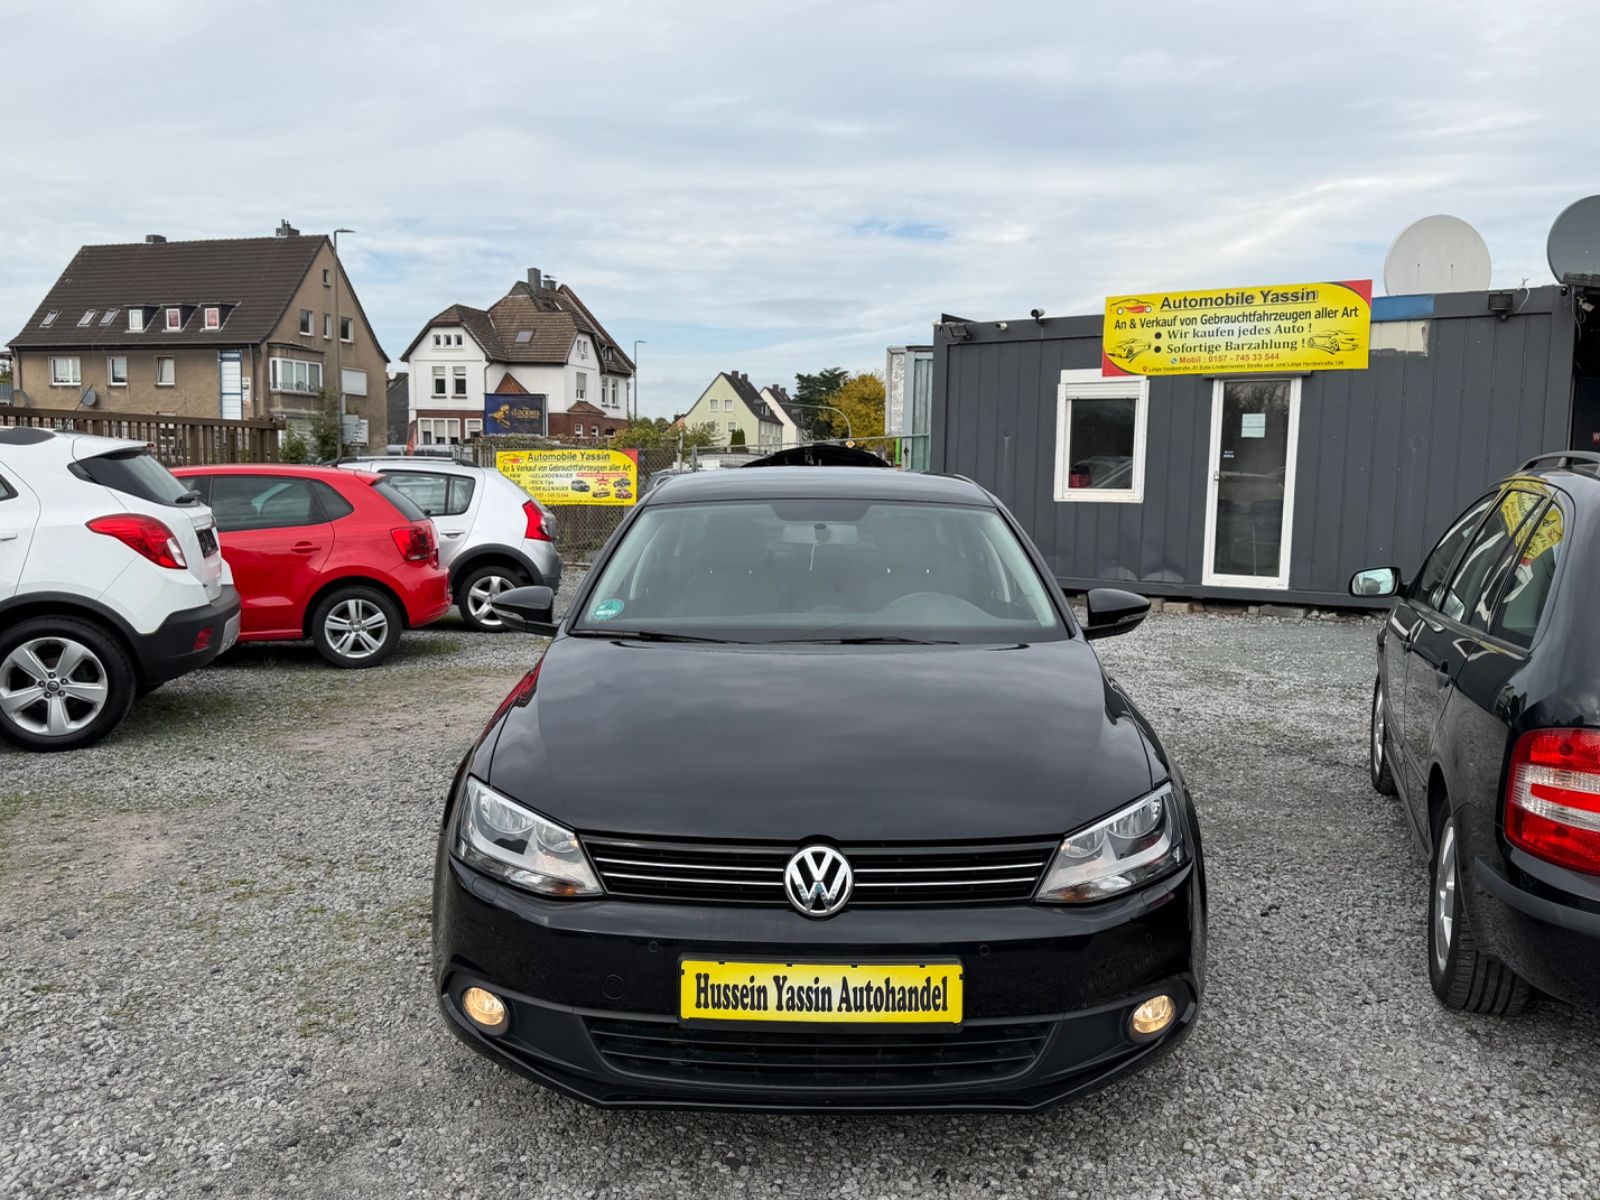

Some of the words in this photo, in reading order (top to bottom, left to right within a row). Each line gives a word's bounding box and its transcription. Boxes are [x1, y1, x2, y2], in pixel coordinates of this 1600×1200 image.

[1160, 291, 1255, 310] Automobile
[1260, 287, 1317, 304] Yassin
[1114, 319, 1126, 331] An
[1129, 318, 1137, 330] &
[1140, 315, 1178, 329] Verkauf
[1180, 316, 1198, 327] von
[1200, 309, 1312, 326] Gebrauchtfahrzeugen
[1314, 307, 1339, 319] aller
[1341, 306, 1359, 318] Art
[1167, 329, 1190, 340] Wir
[1192, 327, 1235, 339] kaufen
[1238, 325, 1271, 338] jedes
[1274, 324, 1304, 335] Auto
[1166, 343, 1221, 355] Sofortige
[1225, 339, 1298, 352] Barzahlung
[1179, 356, 1201, 364] Mobil
[1208, 354, 1228, 363] 0157
[1264, 352, 1280, 361] 544
[528, 452, 577, 461] Automobile
[580, 451, 610, 461] Yassin
[517, 464, 537, 472] Verkauf
[695, 973, 768, 1010] Hussein
[773, 975, 832, 1012] Yassin
[837, 976, 948, 1012] Autohandel
